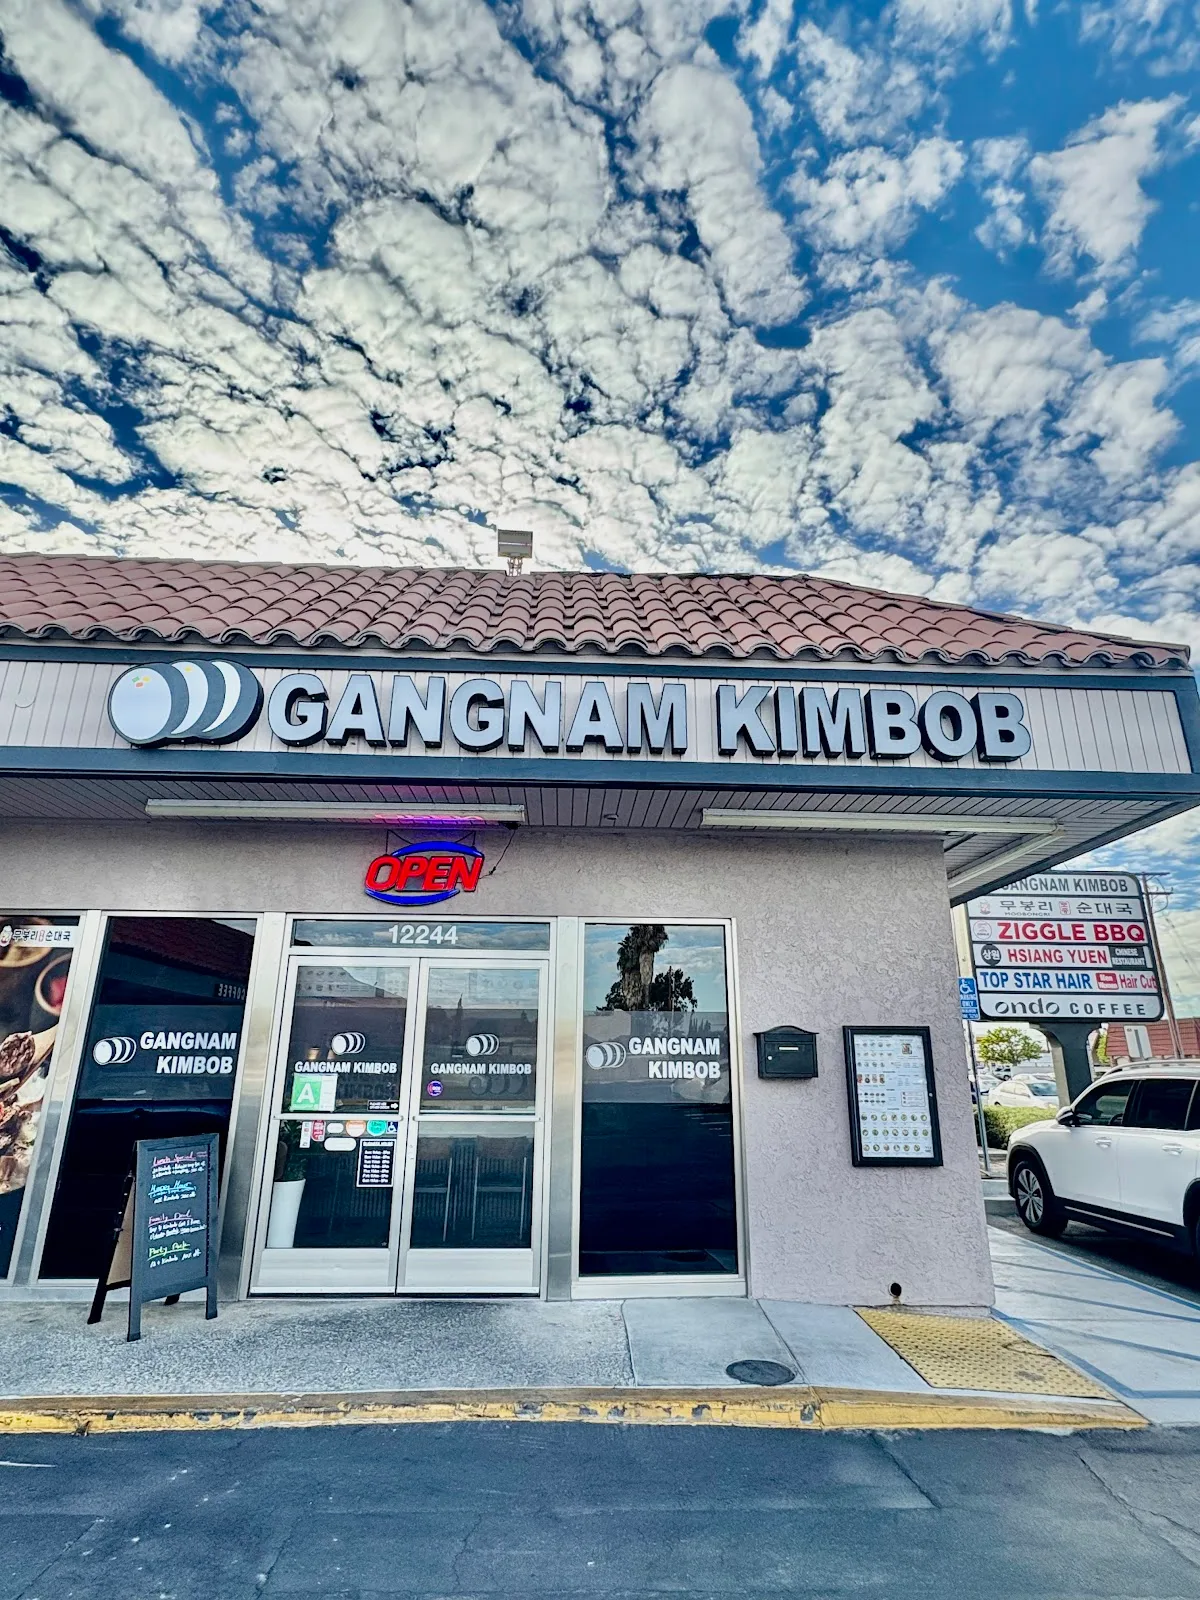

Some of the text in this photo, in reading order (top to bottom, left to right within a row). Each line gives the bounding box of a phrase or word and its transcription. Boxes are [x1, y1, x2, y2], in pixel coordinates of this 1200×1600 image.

[267, 673, 1032, 763] GANGNAM KIMBOB
[365, 856, 484, 892] OPEN
[1073, 878, 1128, 892] KIMBOB
[999, 900, 1053, 912] 무봉리
[1075, 901, 1133, 915] 순대국
[388, 925, 458, 945] 12244
[997, 922, 1145, 942] ZIGGLE BBQ
[1007, 948, 1108, 964] HSIANG YUEN
[979, 972, 1093, 989] TOP STAR HAIR
[1119, 974, 1137, 988] Hair
[995, 998, 1146, 1015] ondo COFFEE
[140, 1032, 238, 1050] GANGNAM
[628, 1037, 720, 1055] GANGNAM
[156, 1056, 233, 1074] KIMBOB
[294, 1061, 397, 1074] GANGNAM KIMBOB
[430, 1062, 532, 1075] GANGNAM KIMBOB
[648, 1061, 721, 1079] KIMBOB
[296, 1082, 315, 1104] A
